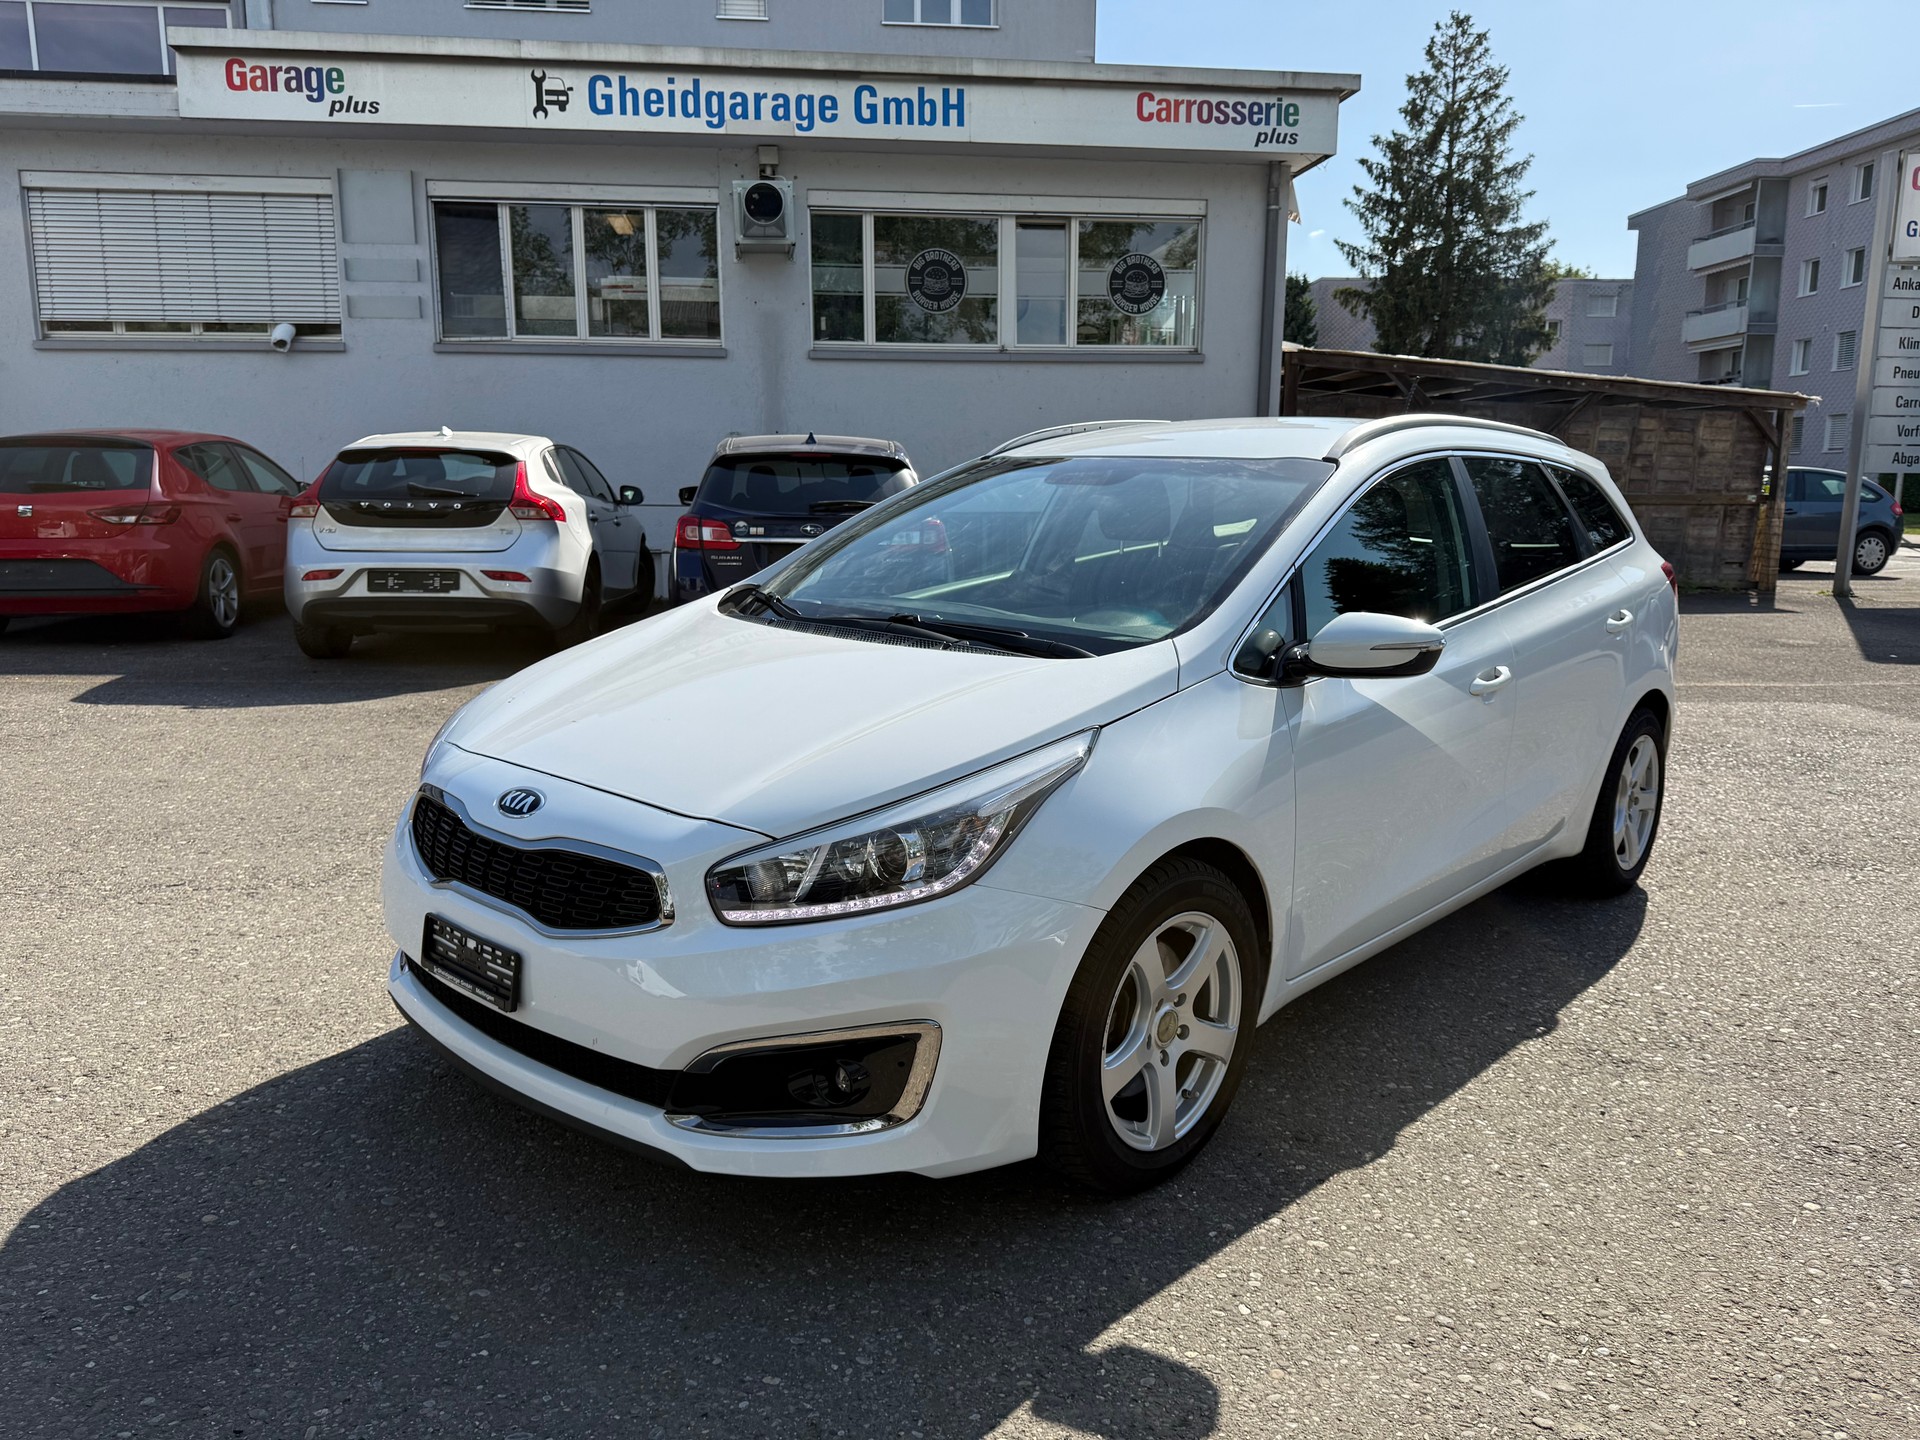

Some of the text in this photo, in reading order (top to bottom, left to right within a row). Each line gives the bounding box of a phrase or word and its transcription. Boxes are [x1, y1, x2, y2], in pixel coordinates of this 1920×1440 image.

[225, 58, 345, 102] Garage
[329, 96, 380, 117] plus
[588, 74, 965, 131] Gheidgarage GmbH
[1136, 92, 1300, 127] Carrosserie
[1254, 128, 1299, 147] plus
[1906, 220, 1920, 237] G
[913, 251, 960, 271] BIG BROTHERS
[1114, 255, 1160, 274] BIG BROTHERS
[912, 290, 960, 310] BURGER HOUSE
[1113, 293, 1160, 313] BURGER HOUSE
[1893, 365, 1920, 379] Pneu
[1895, 395, 1920, 409] Carr
[1897, 424, 1920, 438] Vorf
[1891, 451, 1920, 467] Abga
[360, 502, 462, 510] VOLVO
[501, 790, 536, 813] KIA
